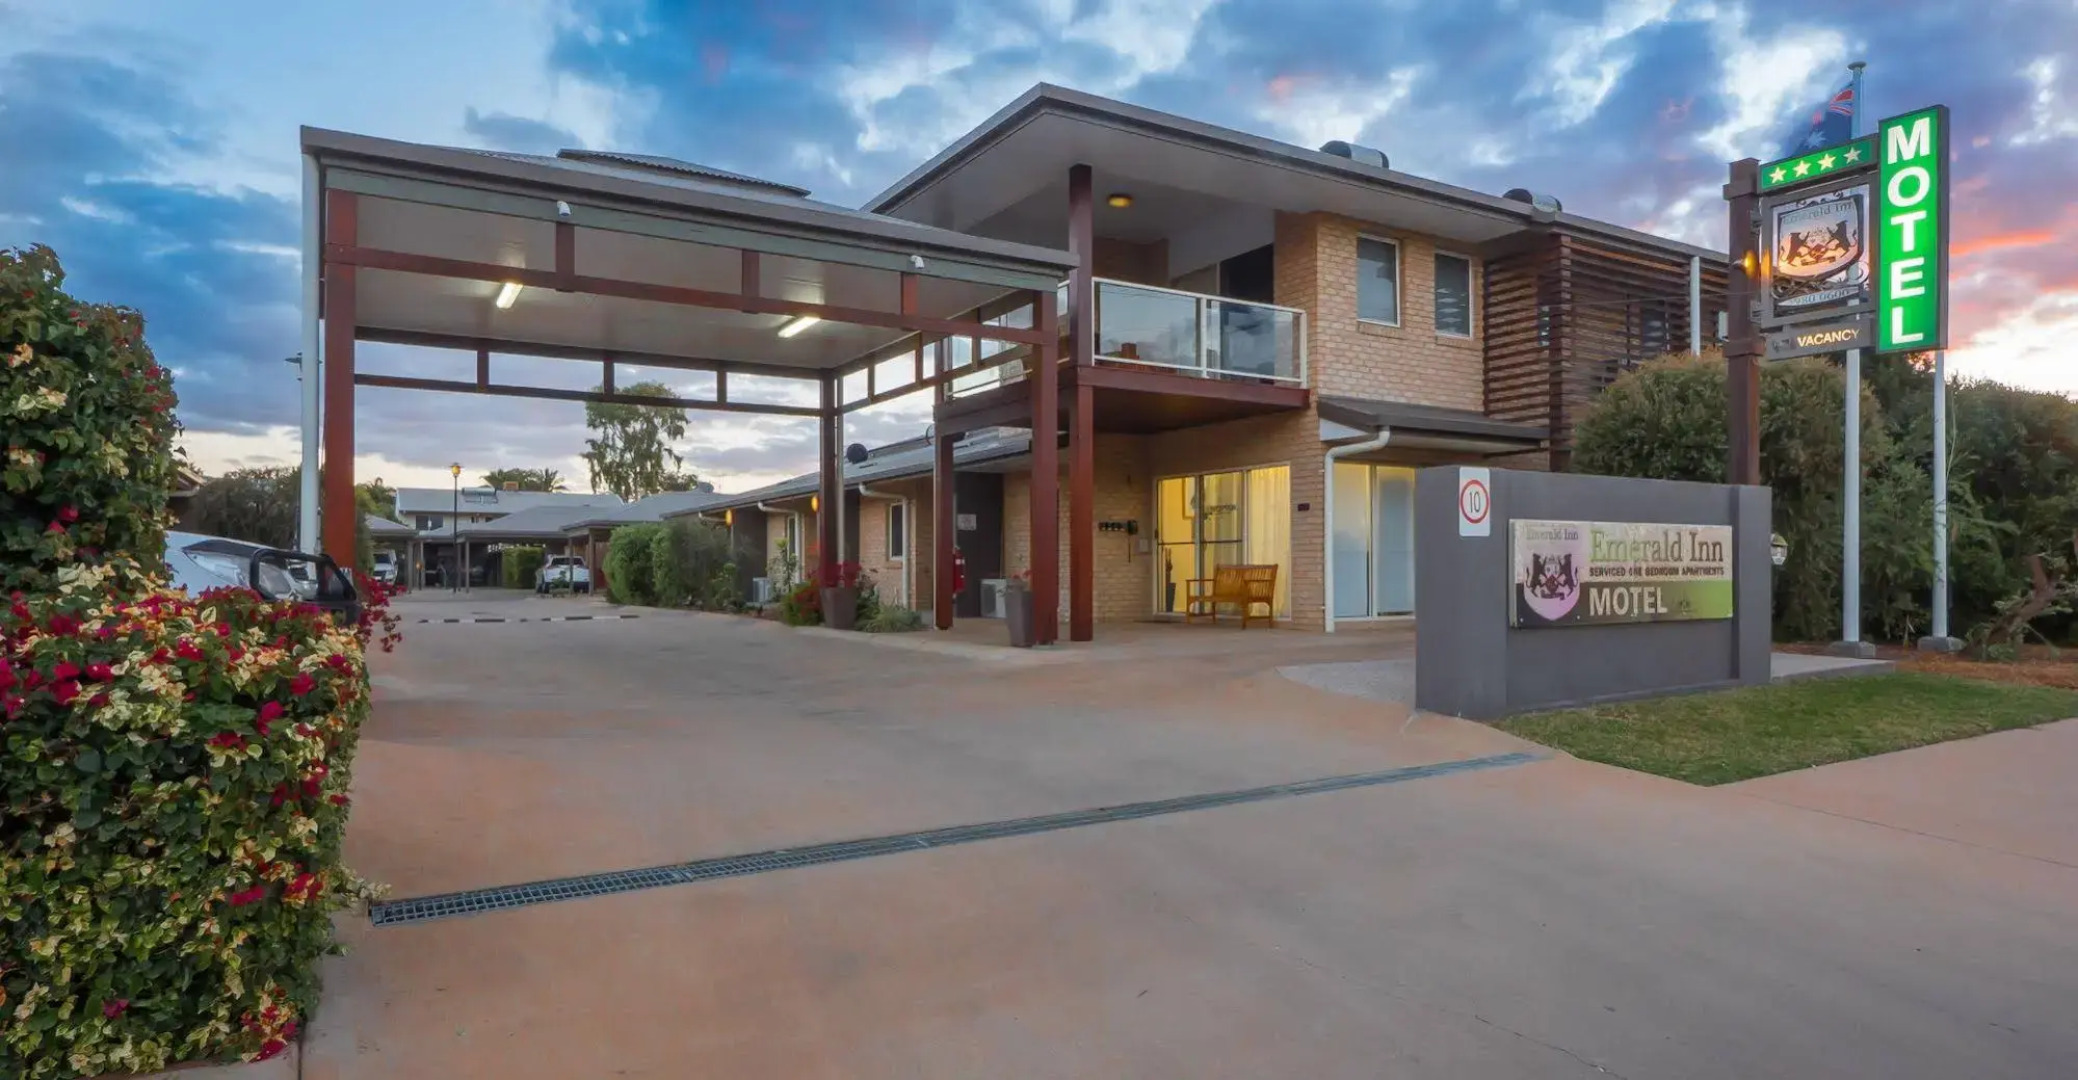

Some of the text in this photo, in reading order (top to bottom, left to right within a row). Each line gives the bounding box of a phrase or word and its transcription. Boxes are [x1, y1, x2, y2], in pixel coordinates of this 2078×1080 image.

[1887, 117, 1930, 345] MOTEL
[1797, 328, 1860, 347] VACANCY
[1469, 491, 1480, 513] 10
[1589, 528, 1724, 563] Emerald Inn
[1589, 566, 1626, 577] SERVICED
[1589, 585, 1668, 617] MOTEL
